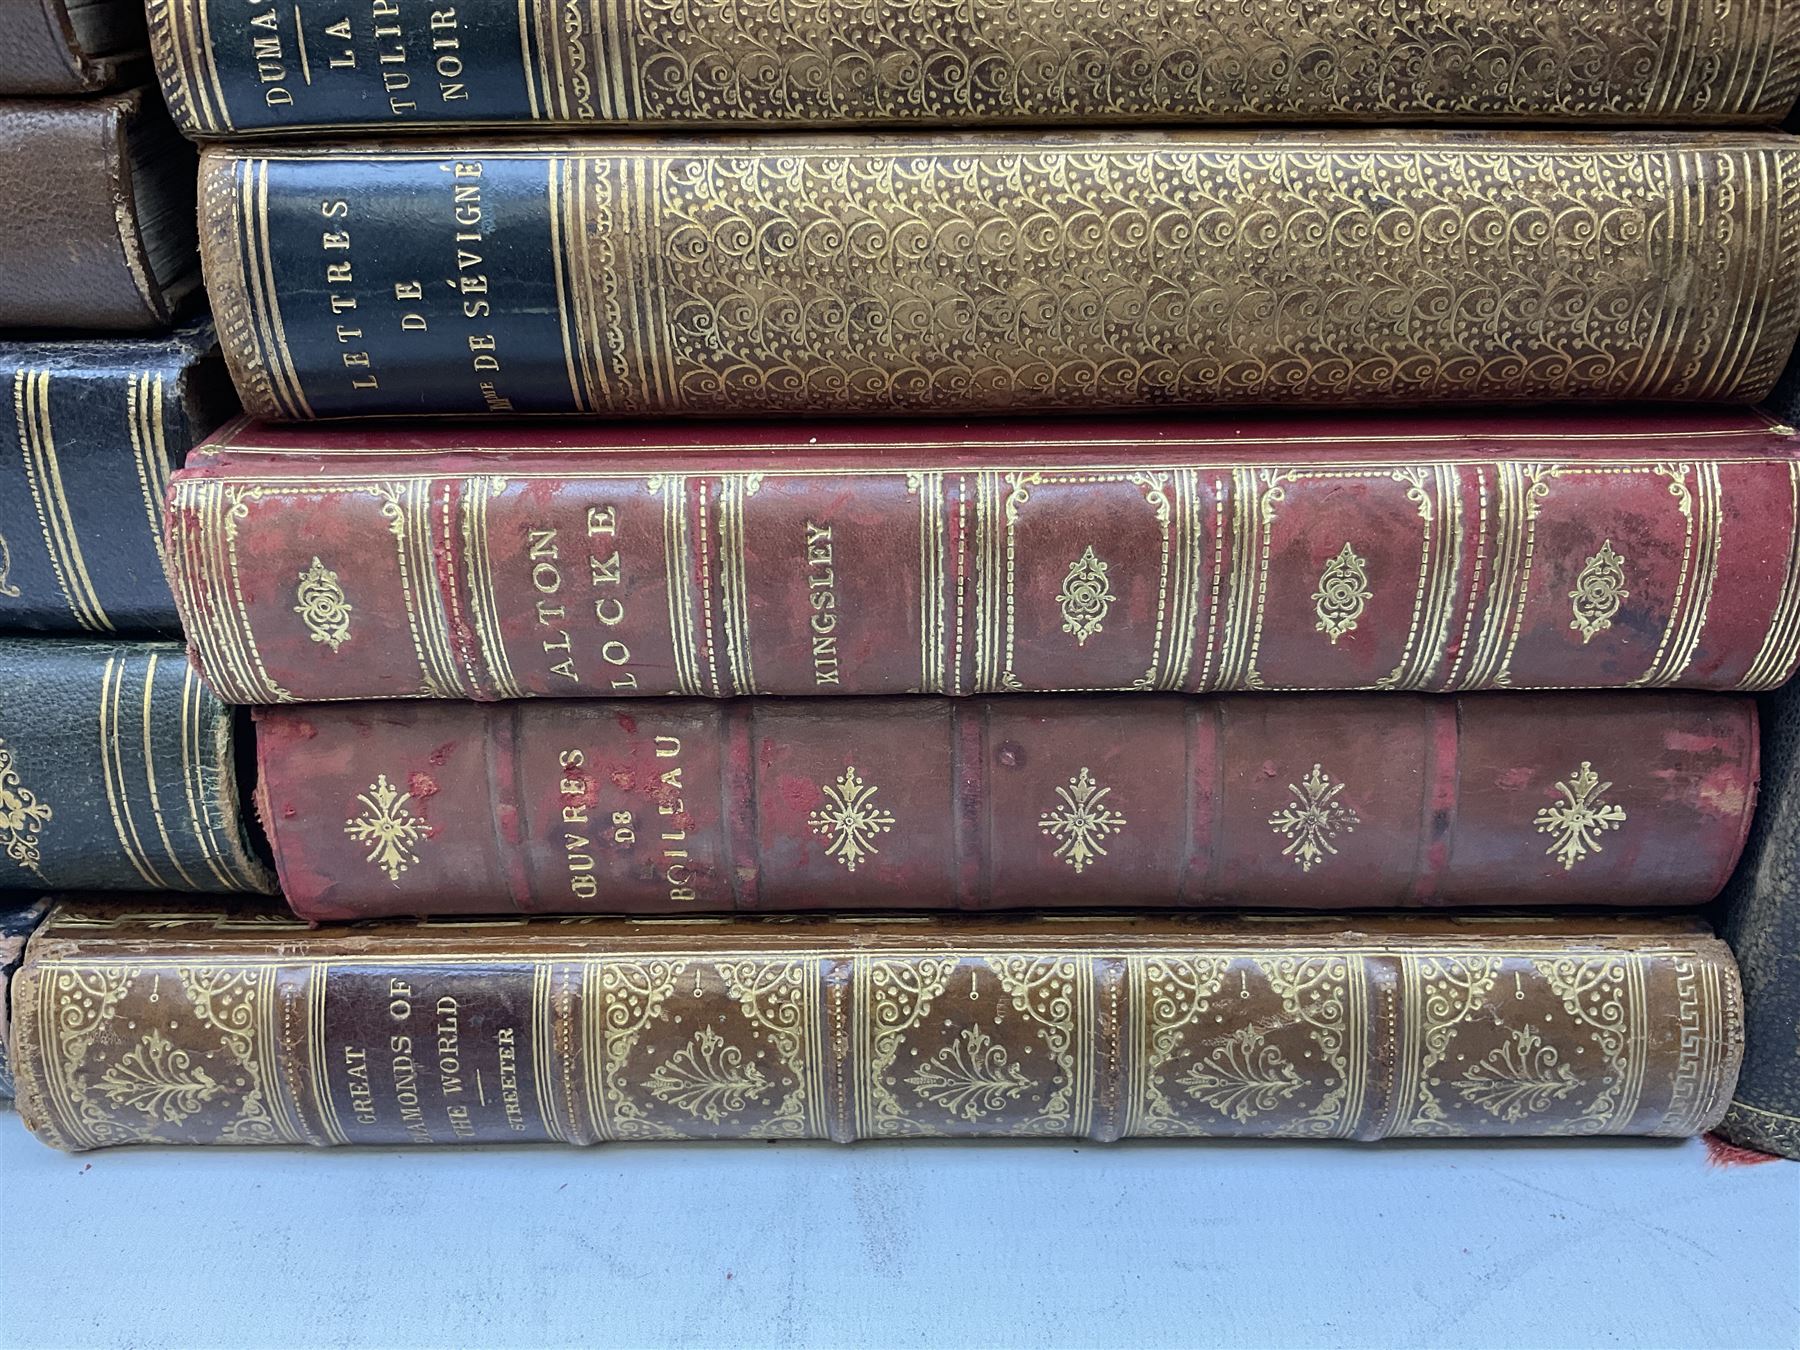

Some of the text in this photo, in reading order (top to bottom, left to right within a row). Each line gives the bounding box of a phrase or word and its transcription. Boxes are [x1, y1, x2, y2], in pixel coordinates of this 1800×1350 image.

[251, 0, 293, 107] DUMA
[325, 17, 356, 69] LA
[430, 7, 468, 101] NOIR
[322, 201, 379, 390] LETTRES
[395, 281, 427, 332] DE
[440, 161, 490, 318] SÉVIGNÉ
[468, 334, 500, 372] DE
[528, 528, 578, 682] ALTON
[587, 506, 637, 690] LOCKE
[806, 520, 839, 686] KINGSLEY
[654, 735, 697, 901] BOILEAU
[344, 1046, 377, 1124] GREAT
[389, 977, 434, 1143] DIAMONDS OF
[437, 996, 476, 1139] THE WORLD
[498, 1027, 526, 1132] STREETER
